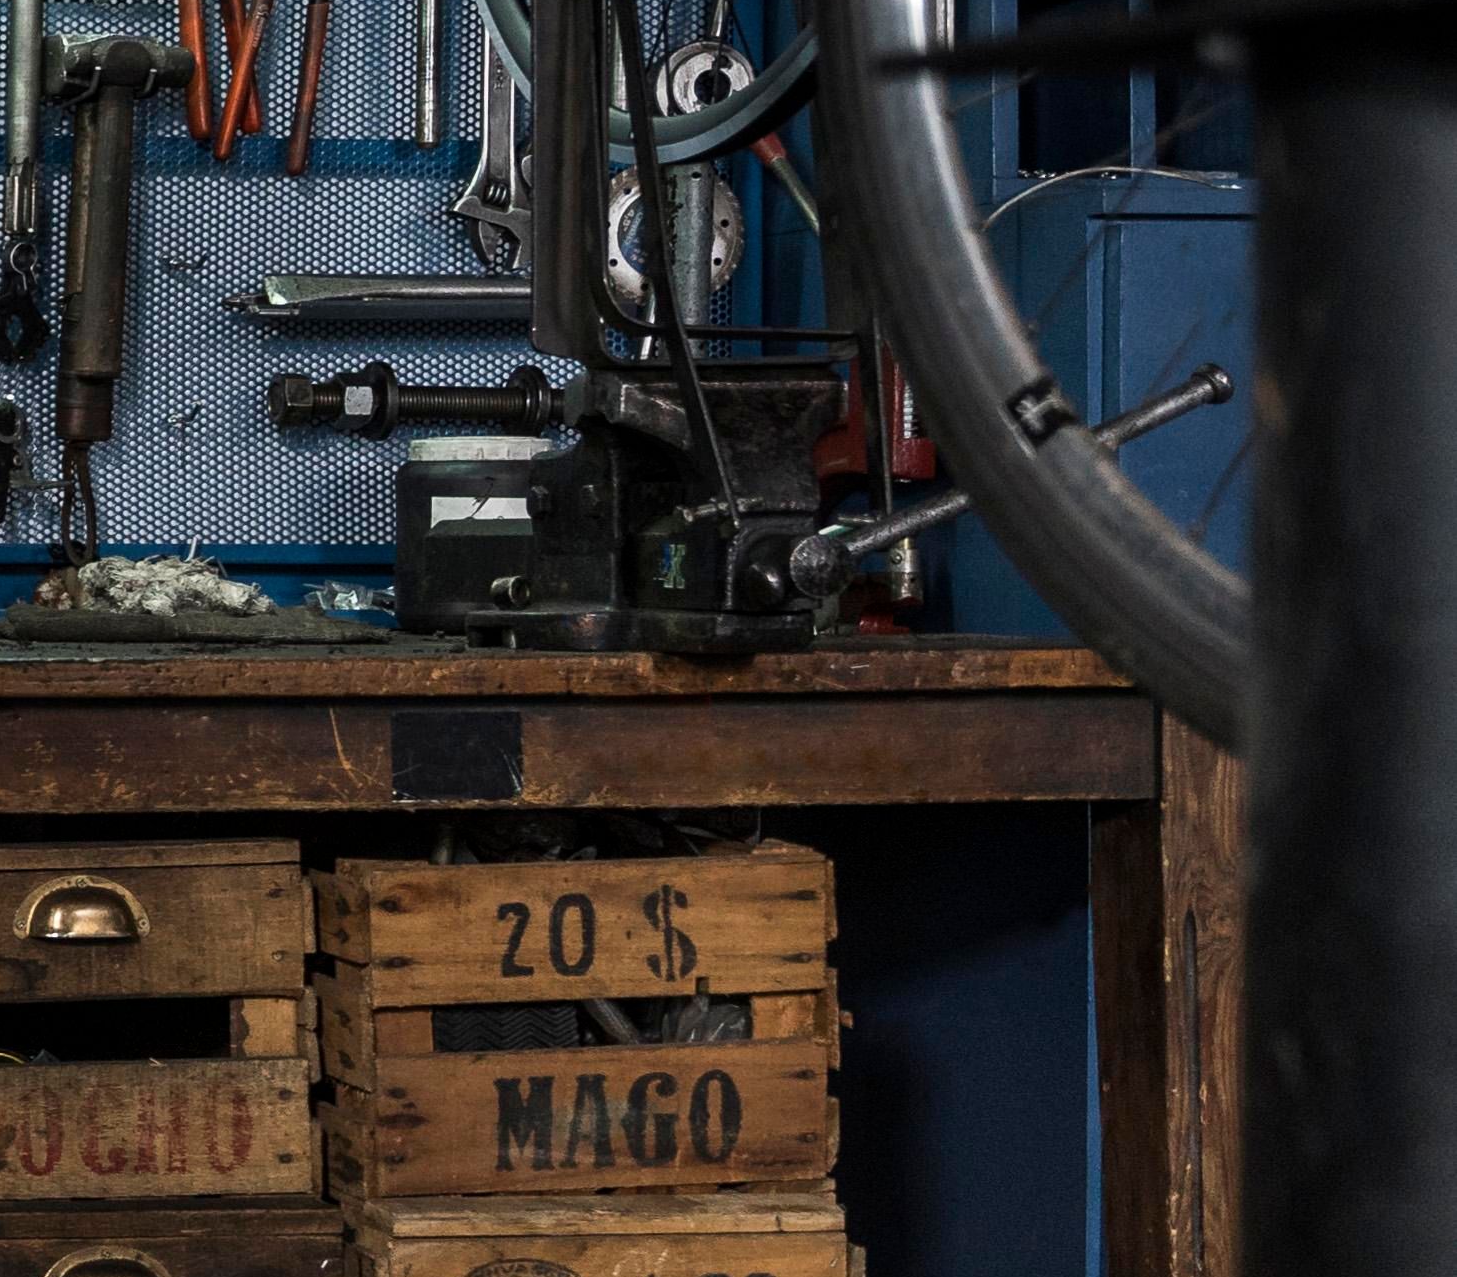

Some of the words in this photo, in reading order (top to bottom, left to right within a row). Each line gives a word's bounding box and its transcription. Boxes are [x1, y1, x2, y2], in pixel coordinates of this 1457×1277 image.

[496, 893, 598, 978] 20
[642, 882, 701, 983] $
[494, 1069, 746, 1173] MAGO
